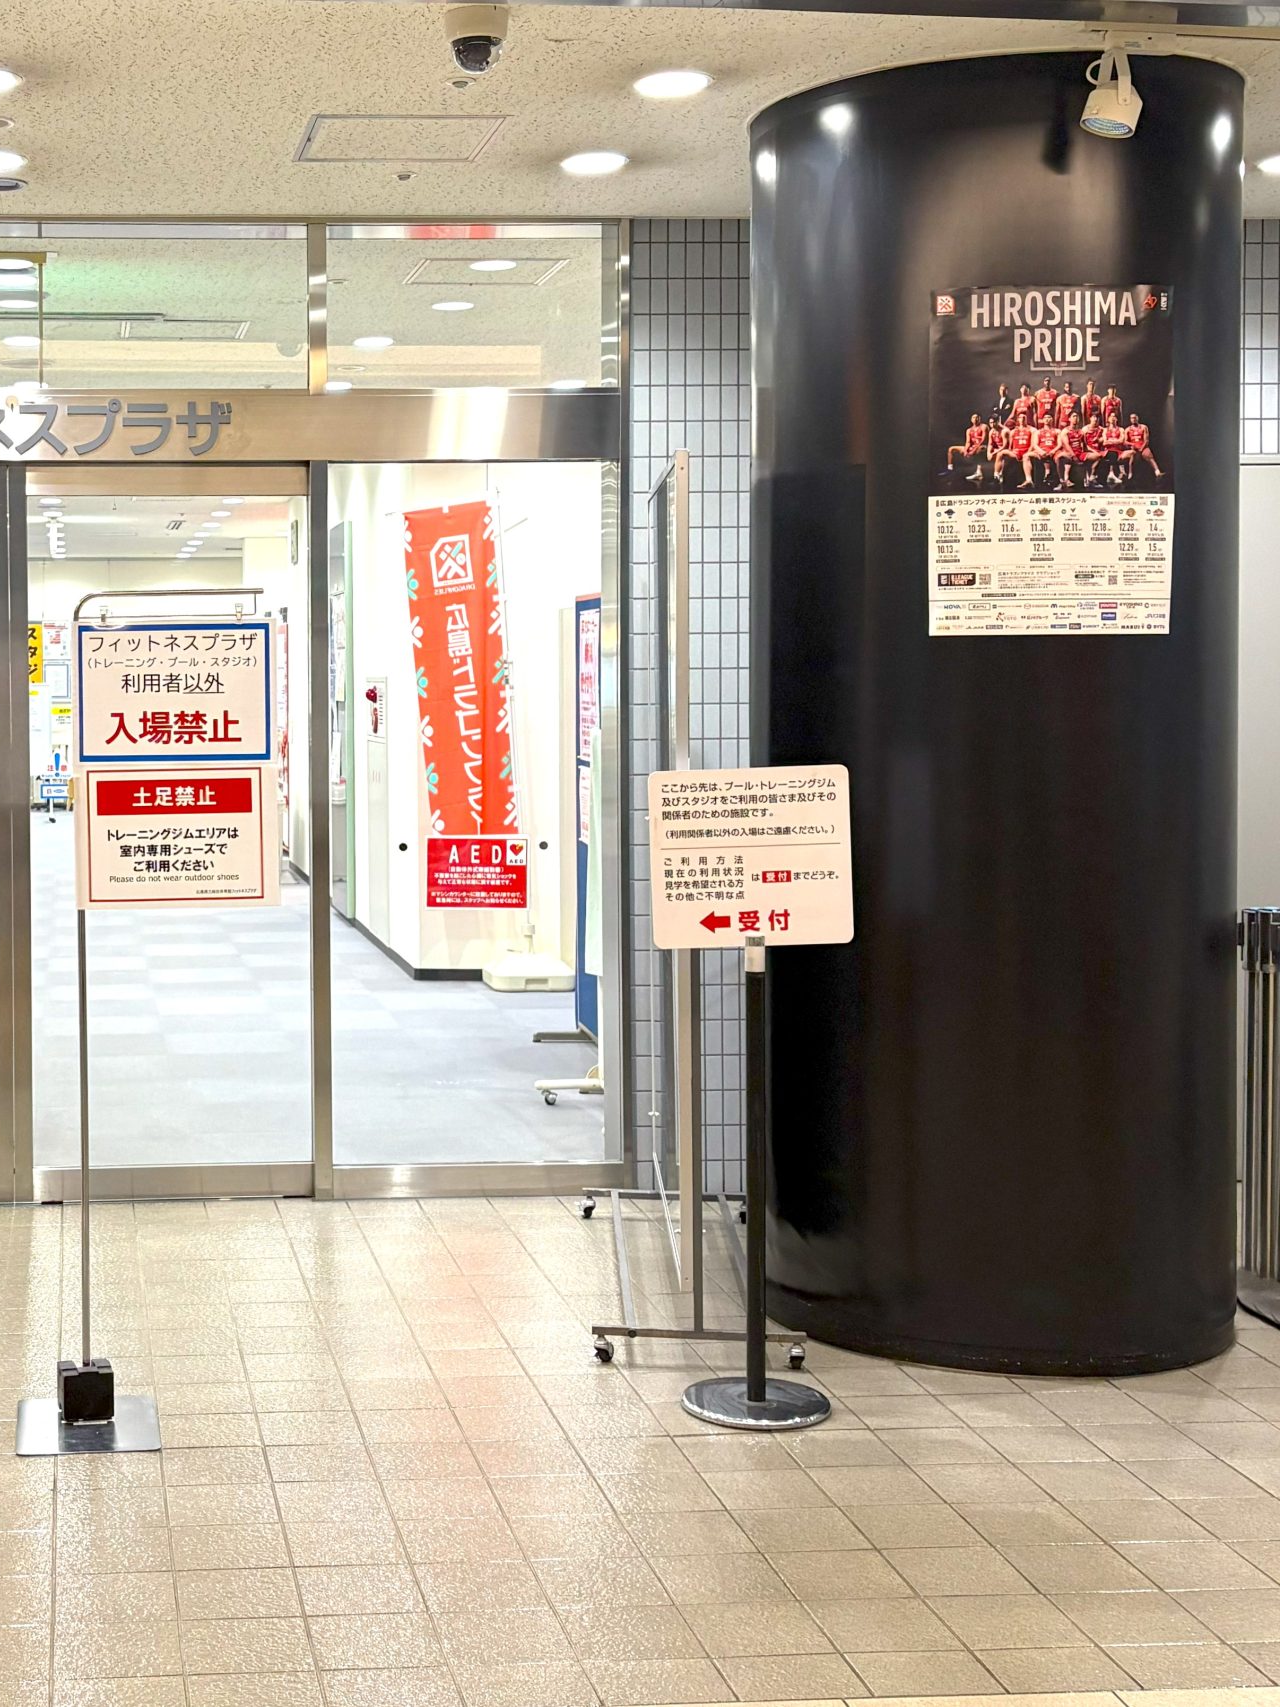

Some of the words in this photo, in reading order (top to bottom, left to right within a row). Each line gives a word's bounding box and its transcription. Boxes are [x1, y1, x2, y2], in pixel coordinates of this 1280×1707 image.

[970, 291, 1137, 328] HIROSHIMA
[1013, 327, 1101, 363] PRIDE
[968, 524, 986, 533] 10.23
[1001, 524, 1015, 532] 11.6
[1063, 522, 1078, 532] 12.11
[1091, 522, 1107, 532] 12.18
[88, 632, 258, 653] フィットネスプラザ
[28, 627, 39, 684] スタジ
[121, 673, 225, 694] 利用者以外
[105, 710, 242, 745] 入場禁止
[661, 778, 836, 793] ここから先は、プール・トレーニングジム
[132, 785, 217, 807] 土足禁止
[661, 792, 837, 807] 及びスタジオをご利用の皆さま及びその
[661, 808, 775, 821] 関係者のための施設です。
[107, 827, 239, 841] トレーニングジムエリアは
[119, 842, 228, 858] 室内専用シューズで
[448, 844, 503, 864] AED
[133, 859, 215, 873] ご利用ください
[663, 855, 744, 866] ご利用方法
[109, 875, 134, 883] Please
[184, 874, 214, 882] outdoor
[664, 867, 745, 878] 現在の利用状況
[765, 871, 788, 882] 受付
[665, 879, 745, 890] 見学を希望される方
[665, 890, 745, 901] その他ご不明な点
[738, 908, 791, 933] 受付
